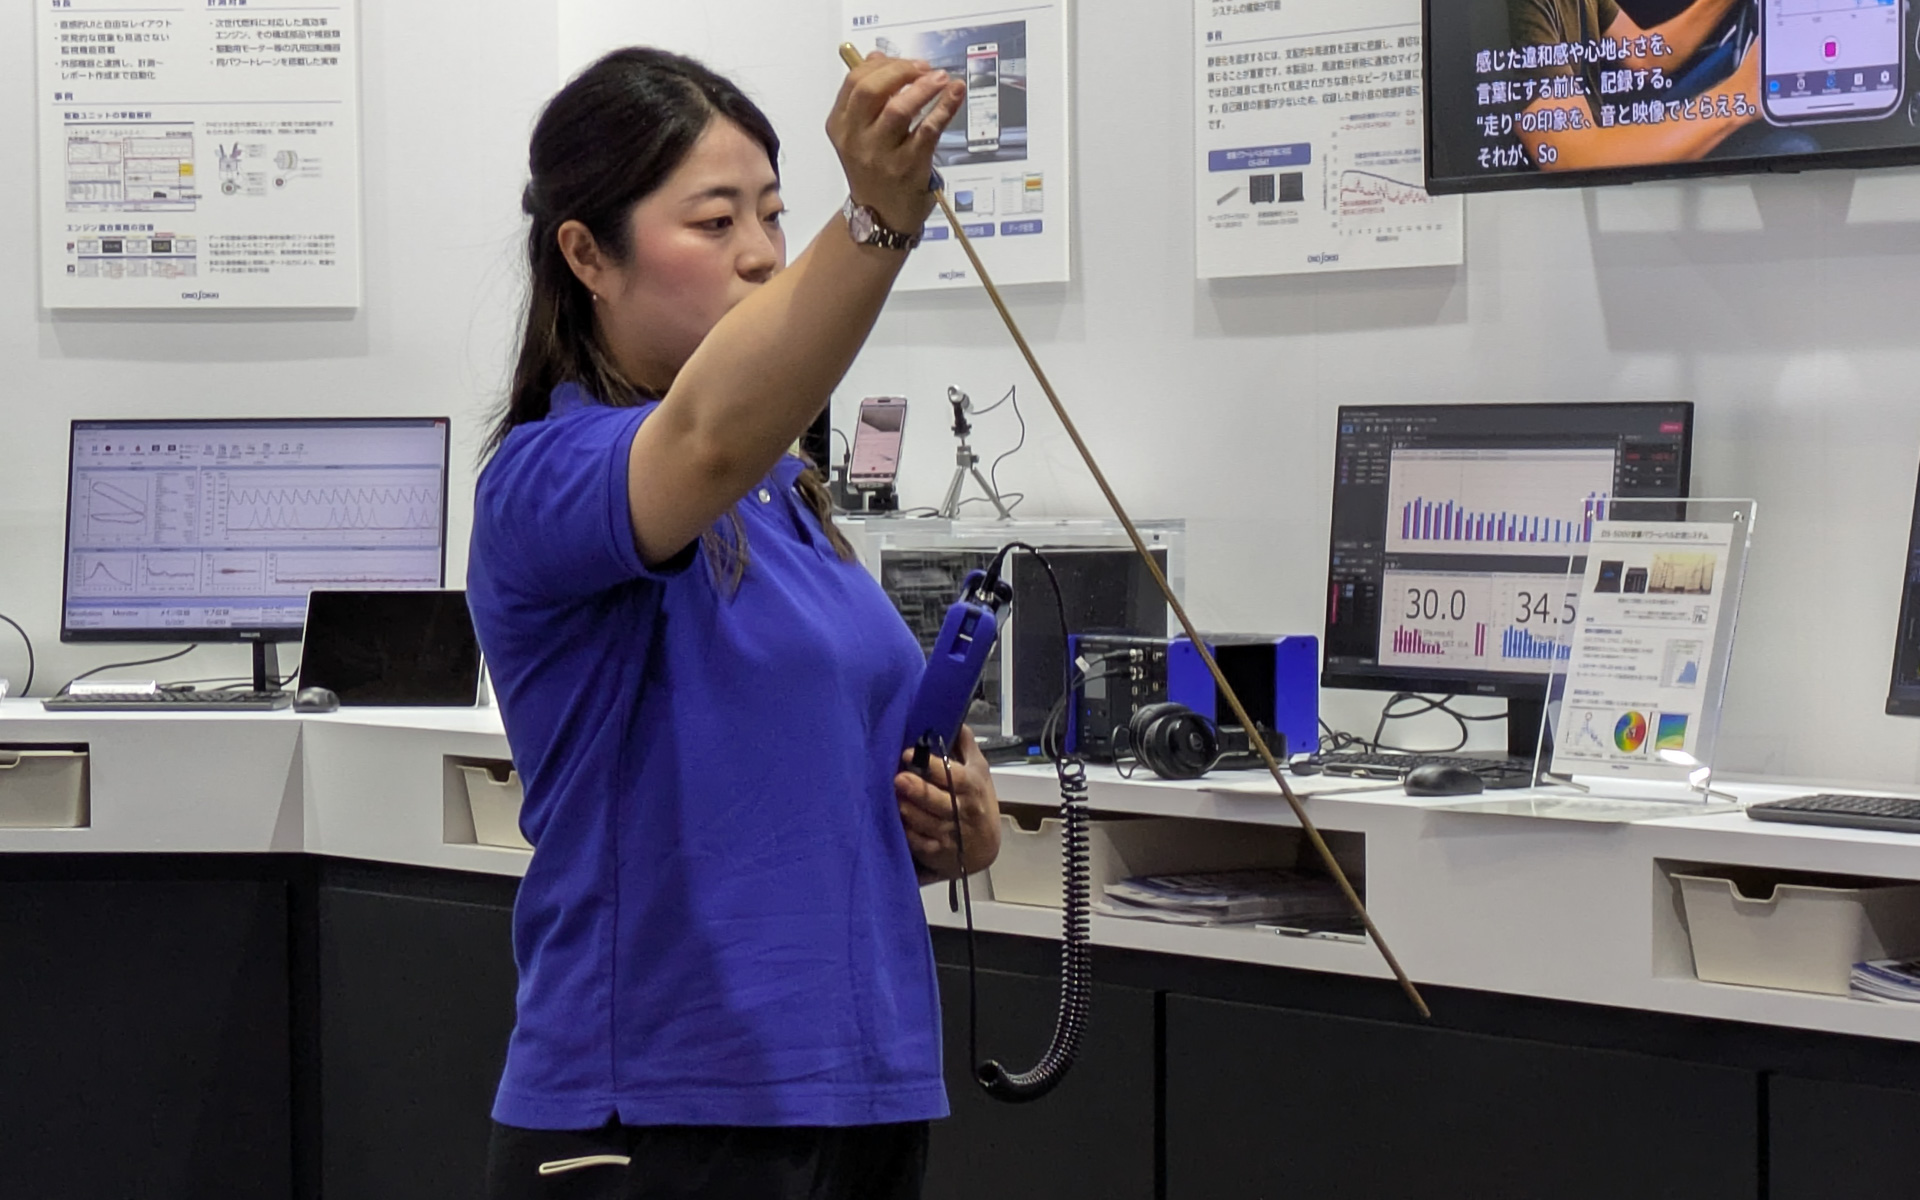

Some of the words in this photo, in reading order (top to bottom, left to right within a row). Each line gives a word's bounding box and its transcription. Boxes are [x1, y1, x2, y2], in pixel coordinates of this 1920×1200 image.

[1476, 34, 1674, 74] 感じた違和感や心地よさを、
[54, 92, 73, 101] 事例
[1406, 588, 1466, 620] 30.0
[1516, 592, 1577, 624] 34.5
